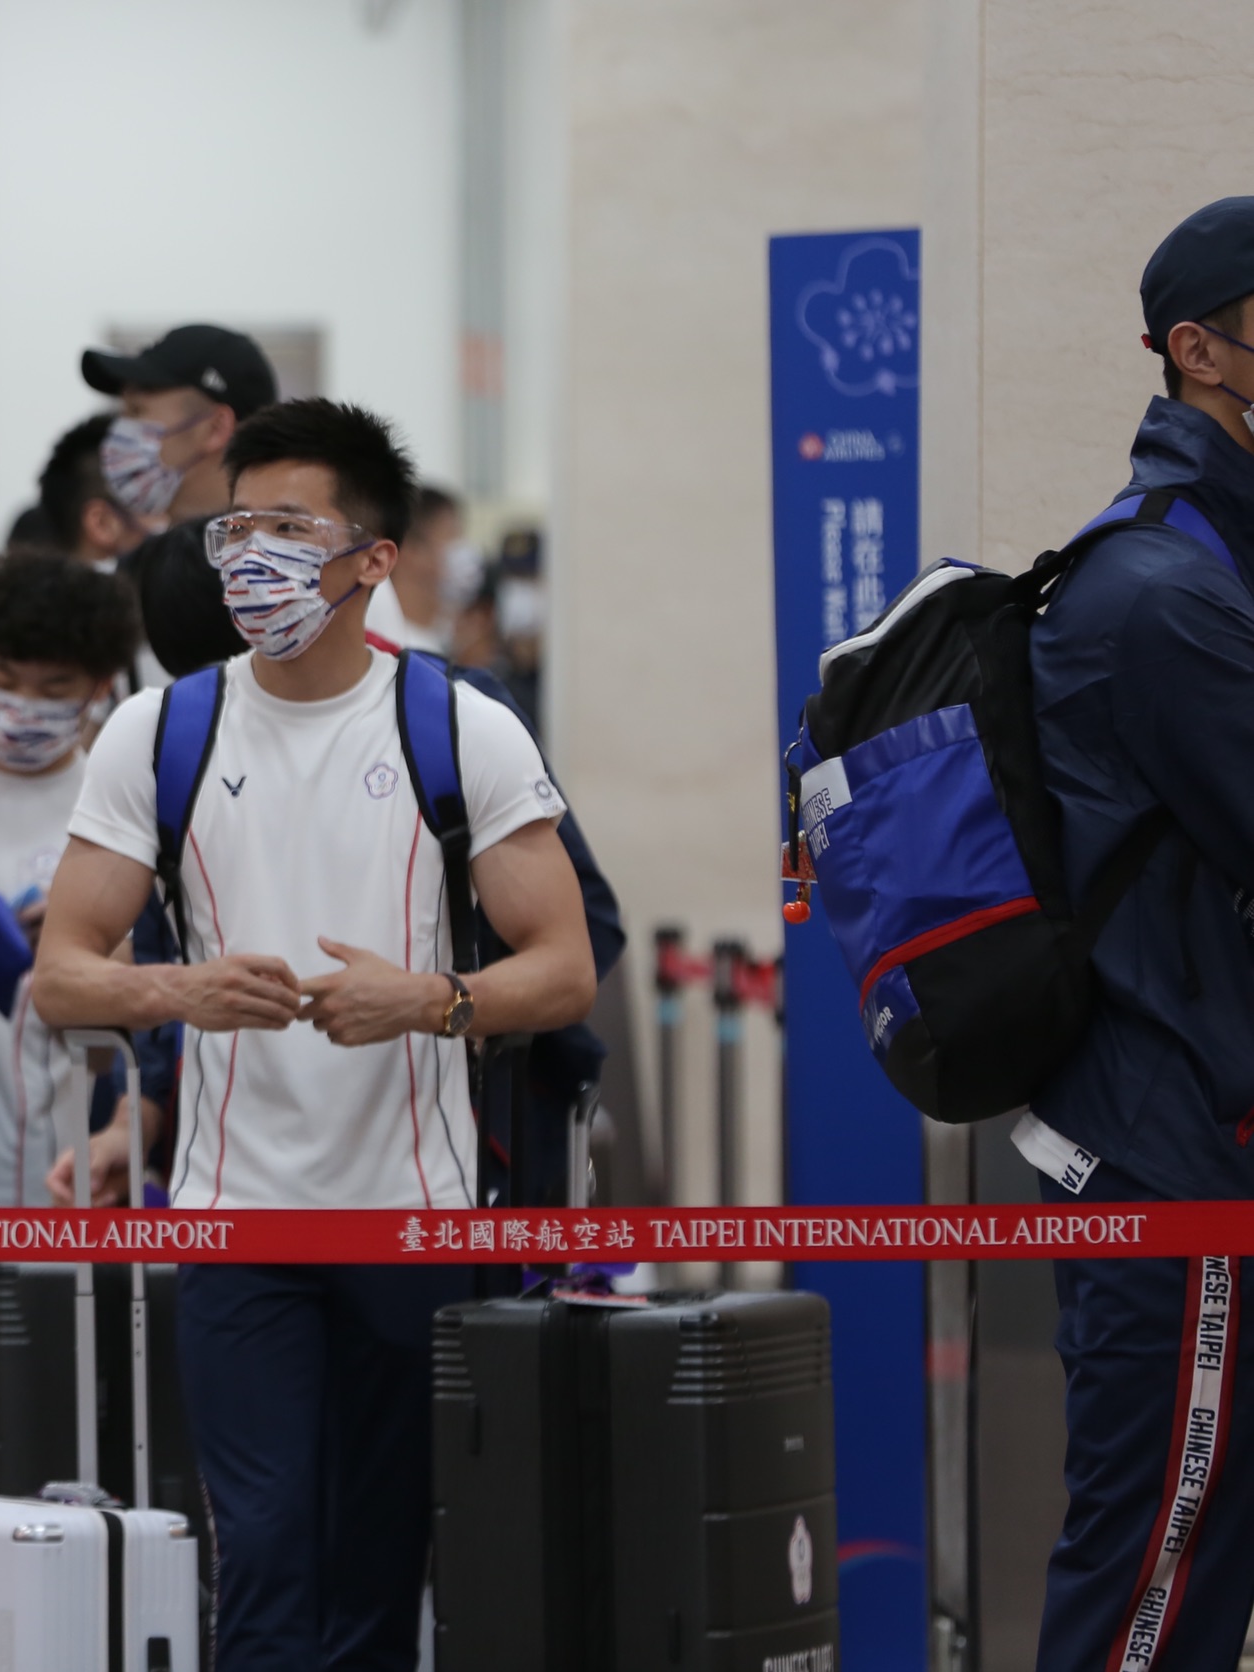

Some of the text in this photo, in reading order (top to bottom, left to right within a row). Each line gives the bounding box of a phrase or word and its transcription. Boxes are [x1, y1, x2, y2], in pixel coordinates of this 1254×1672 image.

[101, 1219, 234, 1250] AIRPORT
[398, 1214, 635, 1252] 臺北國際航空站
[649, 1214, 1147, 1249] TAIPEI INTERNATIONAL AIRPORT
[1197, 1312, 1226, 1371] TAIPEI
[1164, 1407, 1216, 1554] CHINESE TAIPEI
[1125, 1587, 1167, 1666] CHINESE
